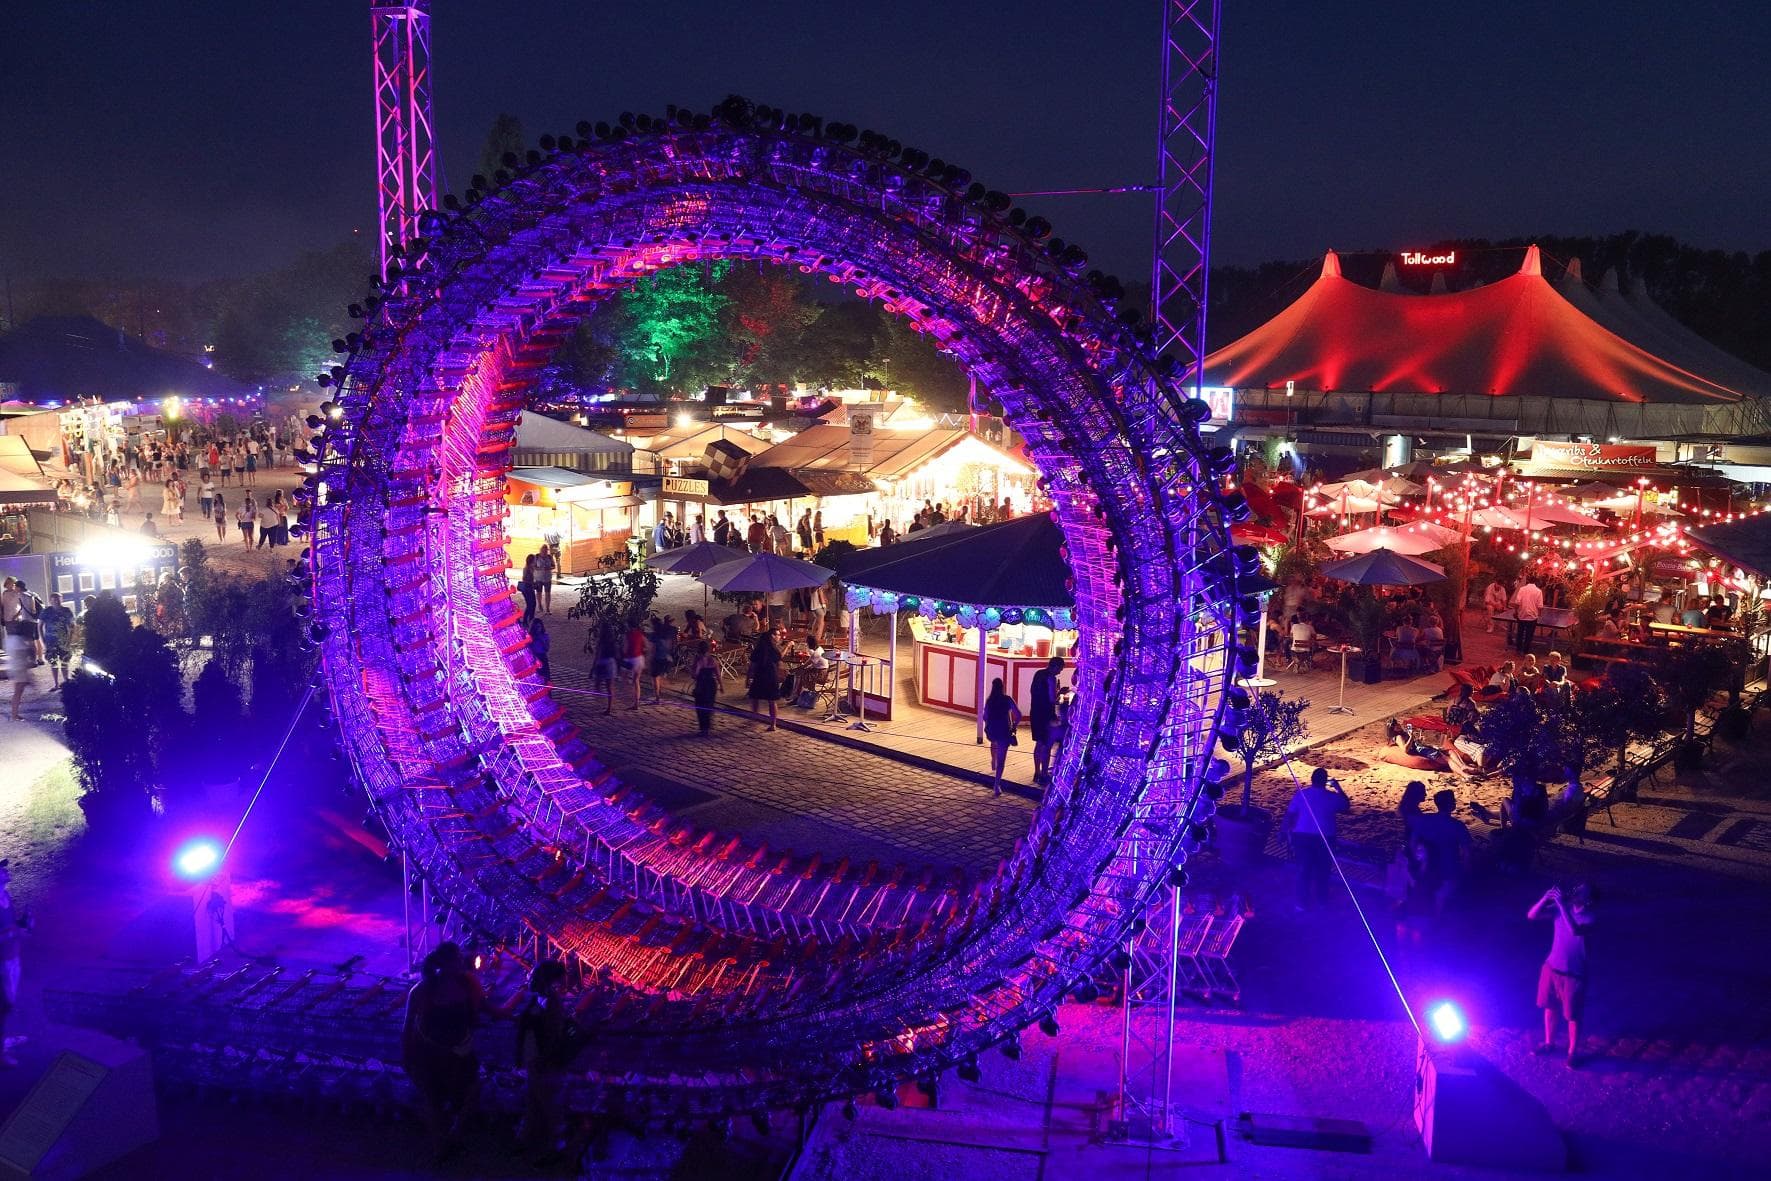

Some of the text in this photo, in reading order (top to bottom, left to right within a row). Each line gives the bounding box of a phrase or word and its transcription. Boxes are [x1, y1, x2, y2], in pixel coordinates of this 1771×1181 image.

[1400, 251, 1455, 265] Tollwood
[1589, 443, 1601, 456] &
[1571, 455, 1653, 467] Ofenkartoffeln
[665, 479, 706, 494] PUZZLES
